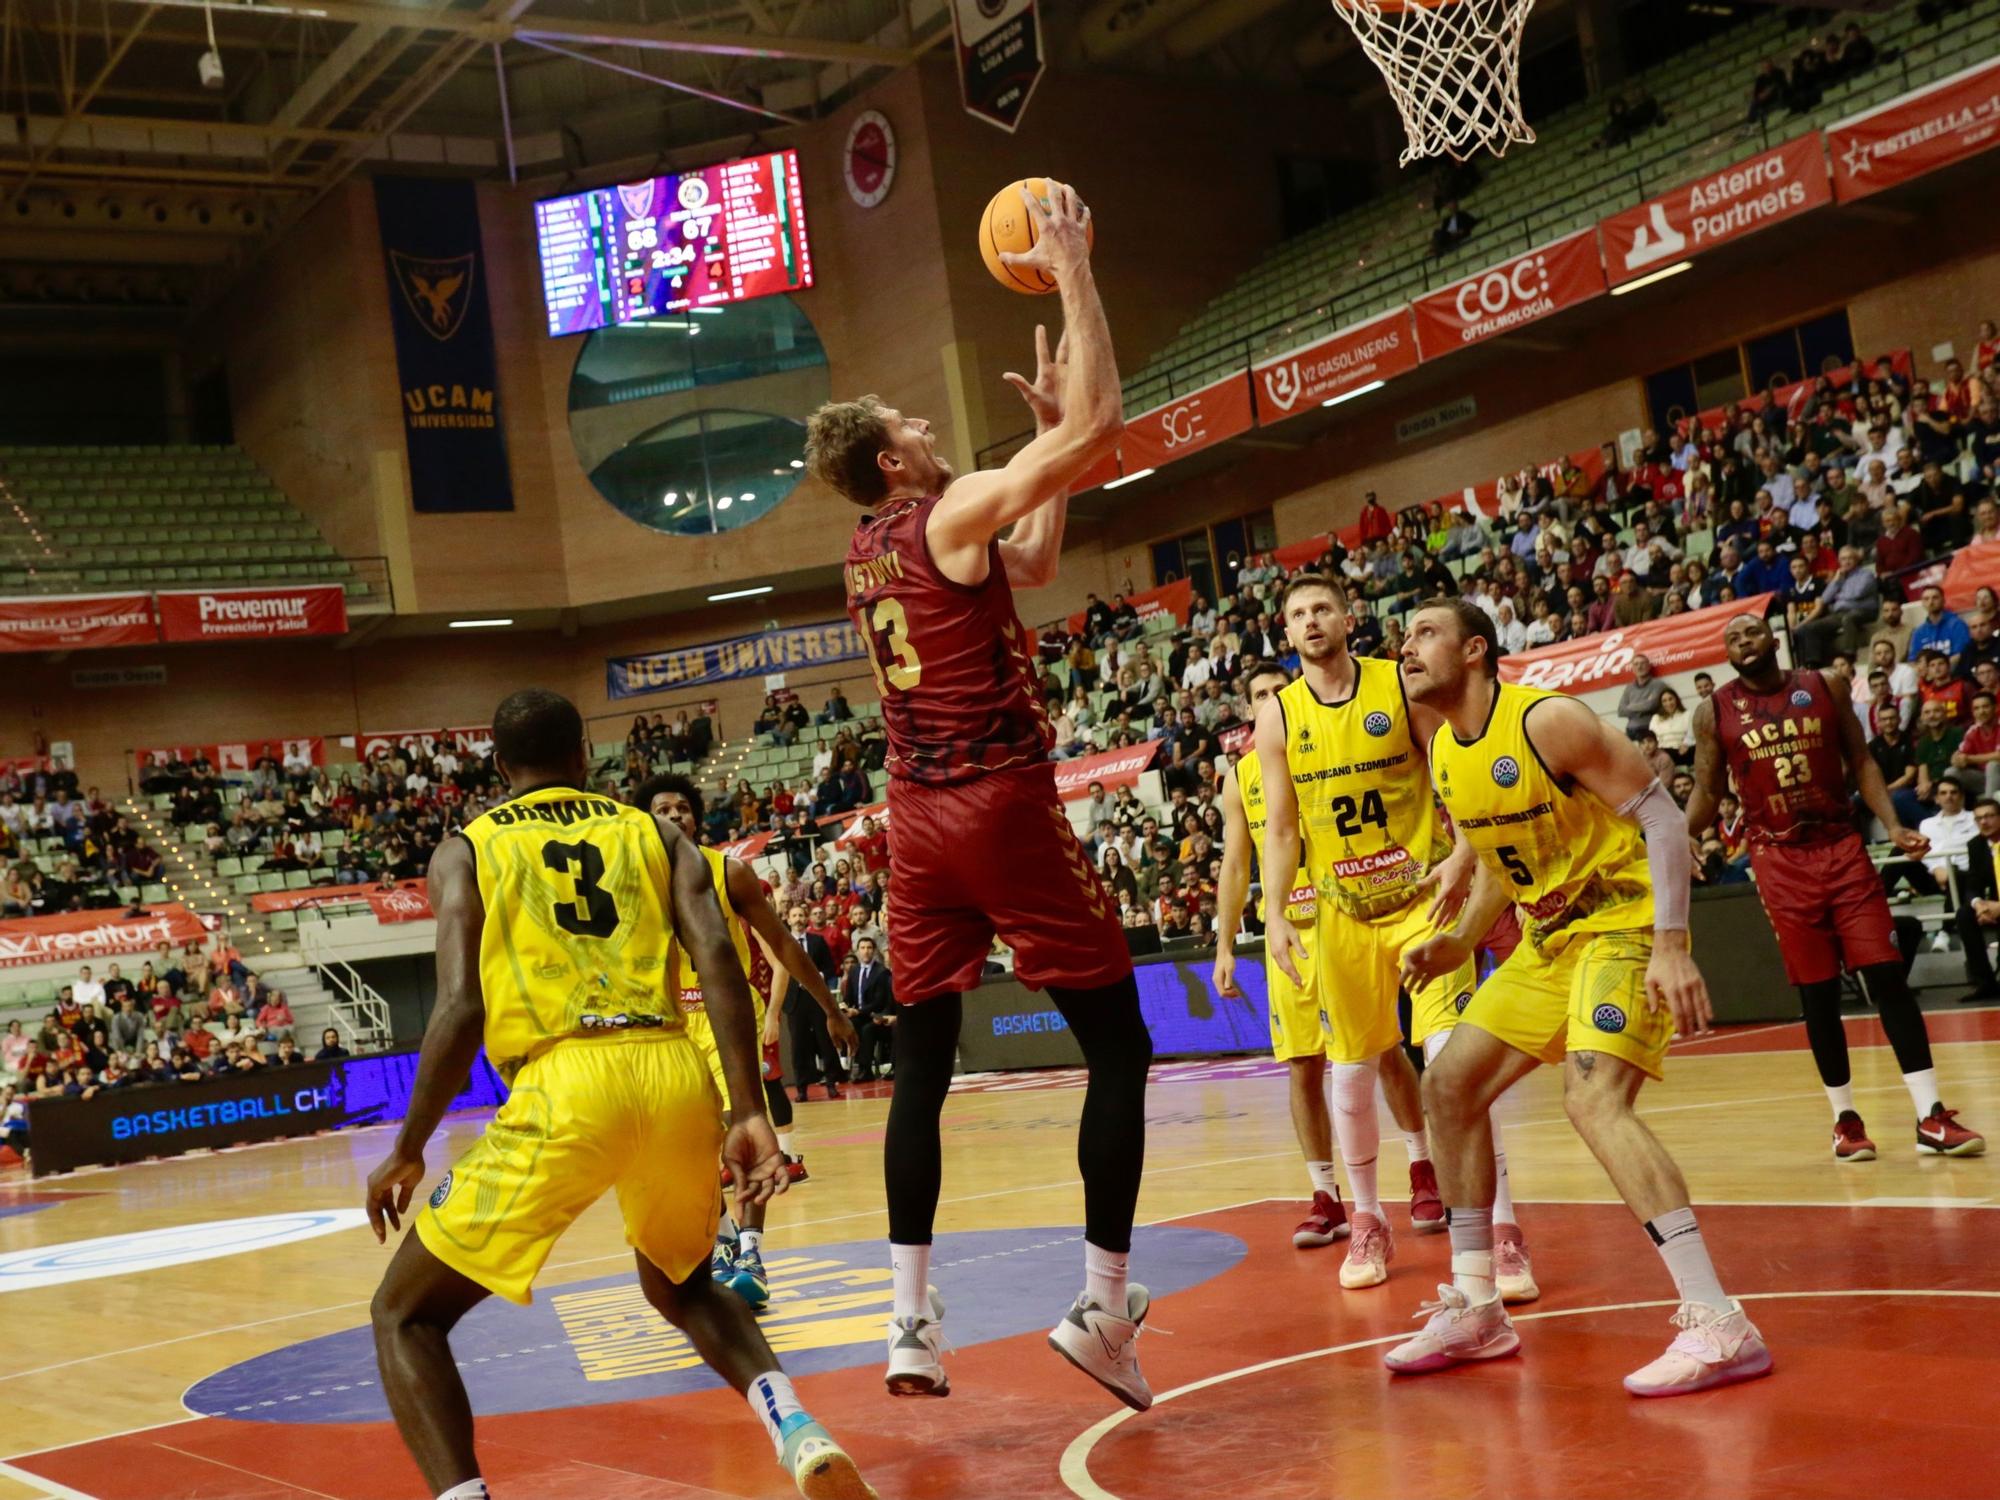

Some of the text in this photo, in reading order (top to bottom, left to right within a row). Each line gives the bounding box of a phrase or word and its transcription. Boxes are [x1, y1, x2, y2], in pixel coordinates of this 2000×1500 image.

[1873, 106, 1975, 158] ESTRELLA
[1690, 155, 1785, 212] Asterra
[683, 216, 712, 239] 67
[1693, 180, 1805, 243] Partners
[1317, 331, 1399, 377] GASOLINERAS
[406, 384, 494, 413] UCAM
[410, 413, 495, 428] UNIVERSIDAD
[82, 613, 149, 628] LEVANTE
[199, 595, 307, 621] Prevemur
[276, 618, 308, 631] Salud
[627, 625, 867, 689] UCAM UNIVERSI
[859, 597, 922, 697] 13
[1741, 717, 1822, 749] UCAM
[1774, 754, 1812, 789] 23
[488, 799, 619, 827] BROWN
[1332, 789, 1388, 838] 24
[1333, 849, 1408, 877] VULCANO
[1496, 845, 1534, 886] 5
[542, 839, 620, 938] 3
[40, 918, 172, 952] realturf
[112, 1094, 291, 1141] BASKETBALL
